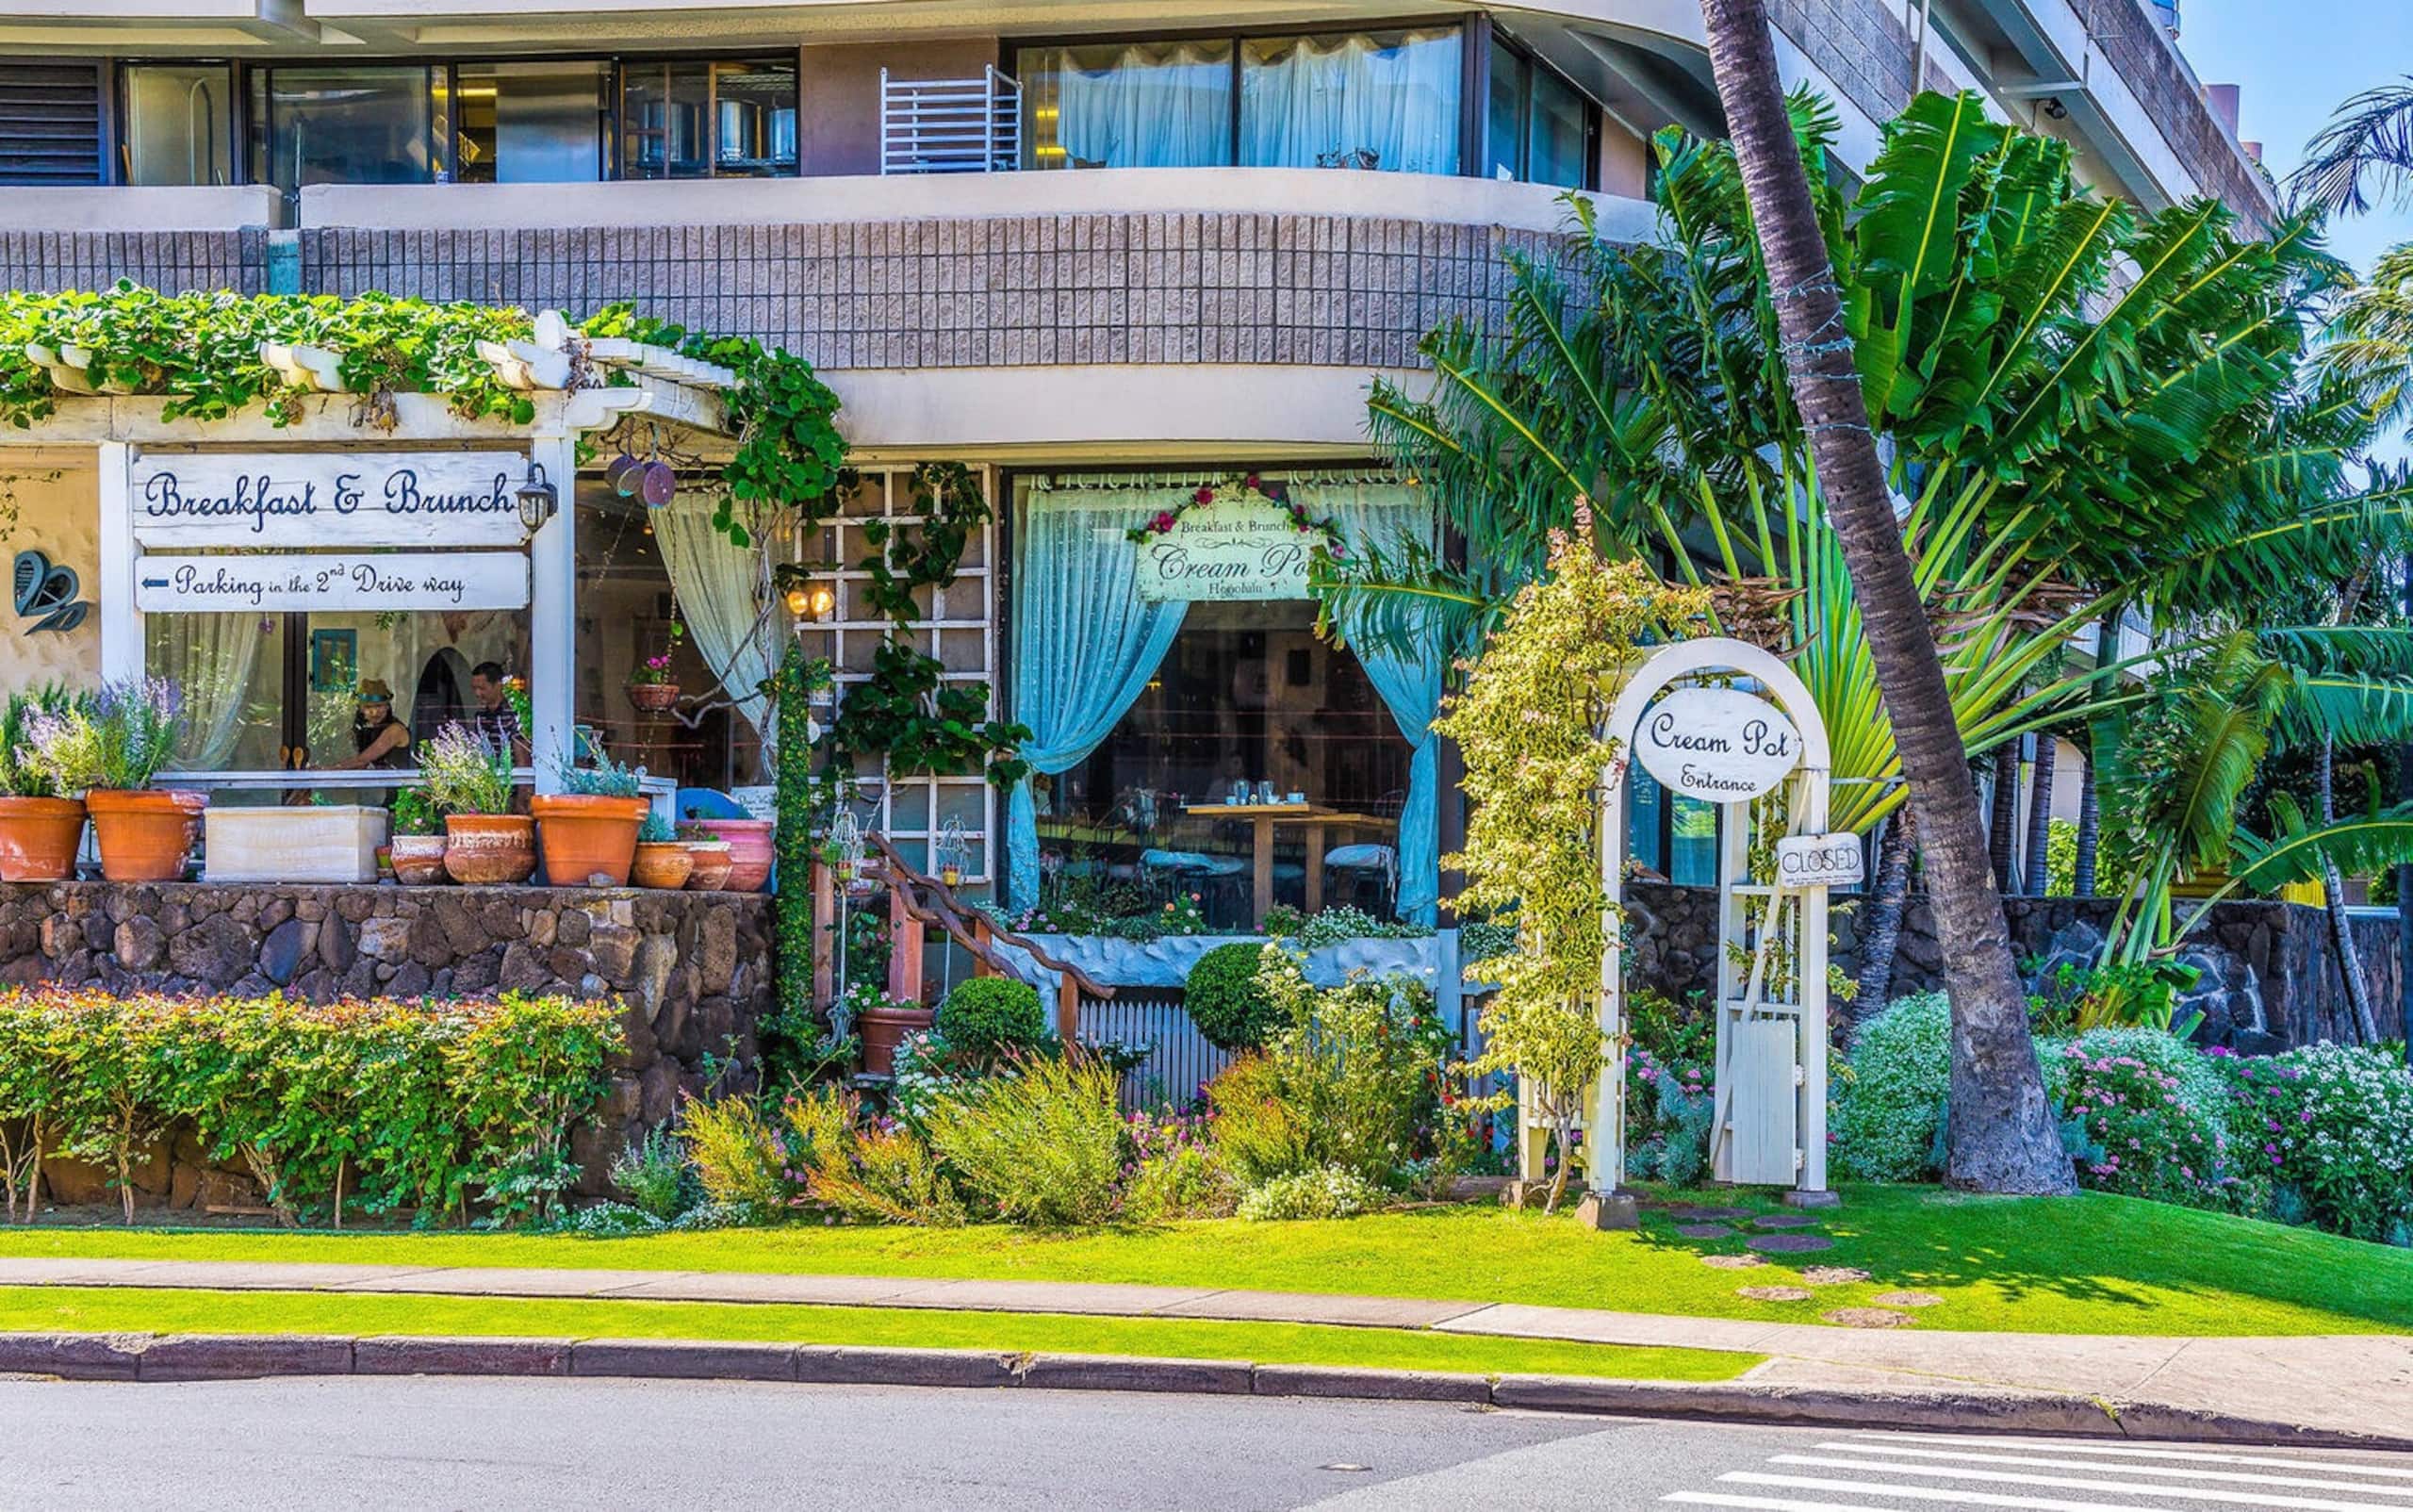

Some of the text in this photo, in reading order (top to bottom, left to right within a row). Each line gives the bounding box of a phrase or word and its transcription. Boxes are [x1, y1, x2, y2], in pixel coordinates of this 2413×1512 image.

[144, 469, 515, 534] Breakfast & Brunch
[1182, 520, 1289, 534] Breakfast & Brunch
[1151, 542, 1308, 581] Cream Po
[175, 566, 264, 604] Parking
[269, 581, 283, 593] in
[288, 574, 311, 593] the
[352, 565, 415, 593] Drive
[423, 579, 466, 602] way
[1650, 712, 1789, 757] Cream Pot
[1681, 764, 1756, 793] Entrance
[1781, 847, 1860, 874] CLOSED
